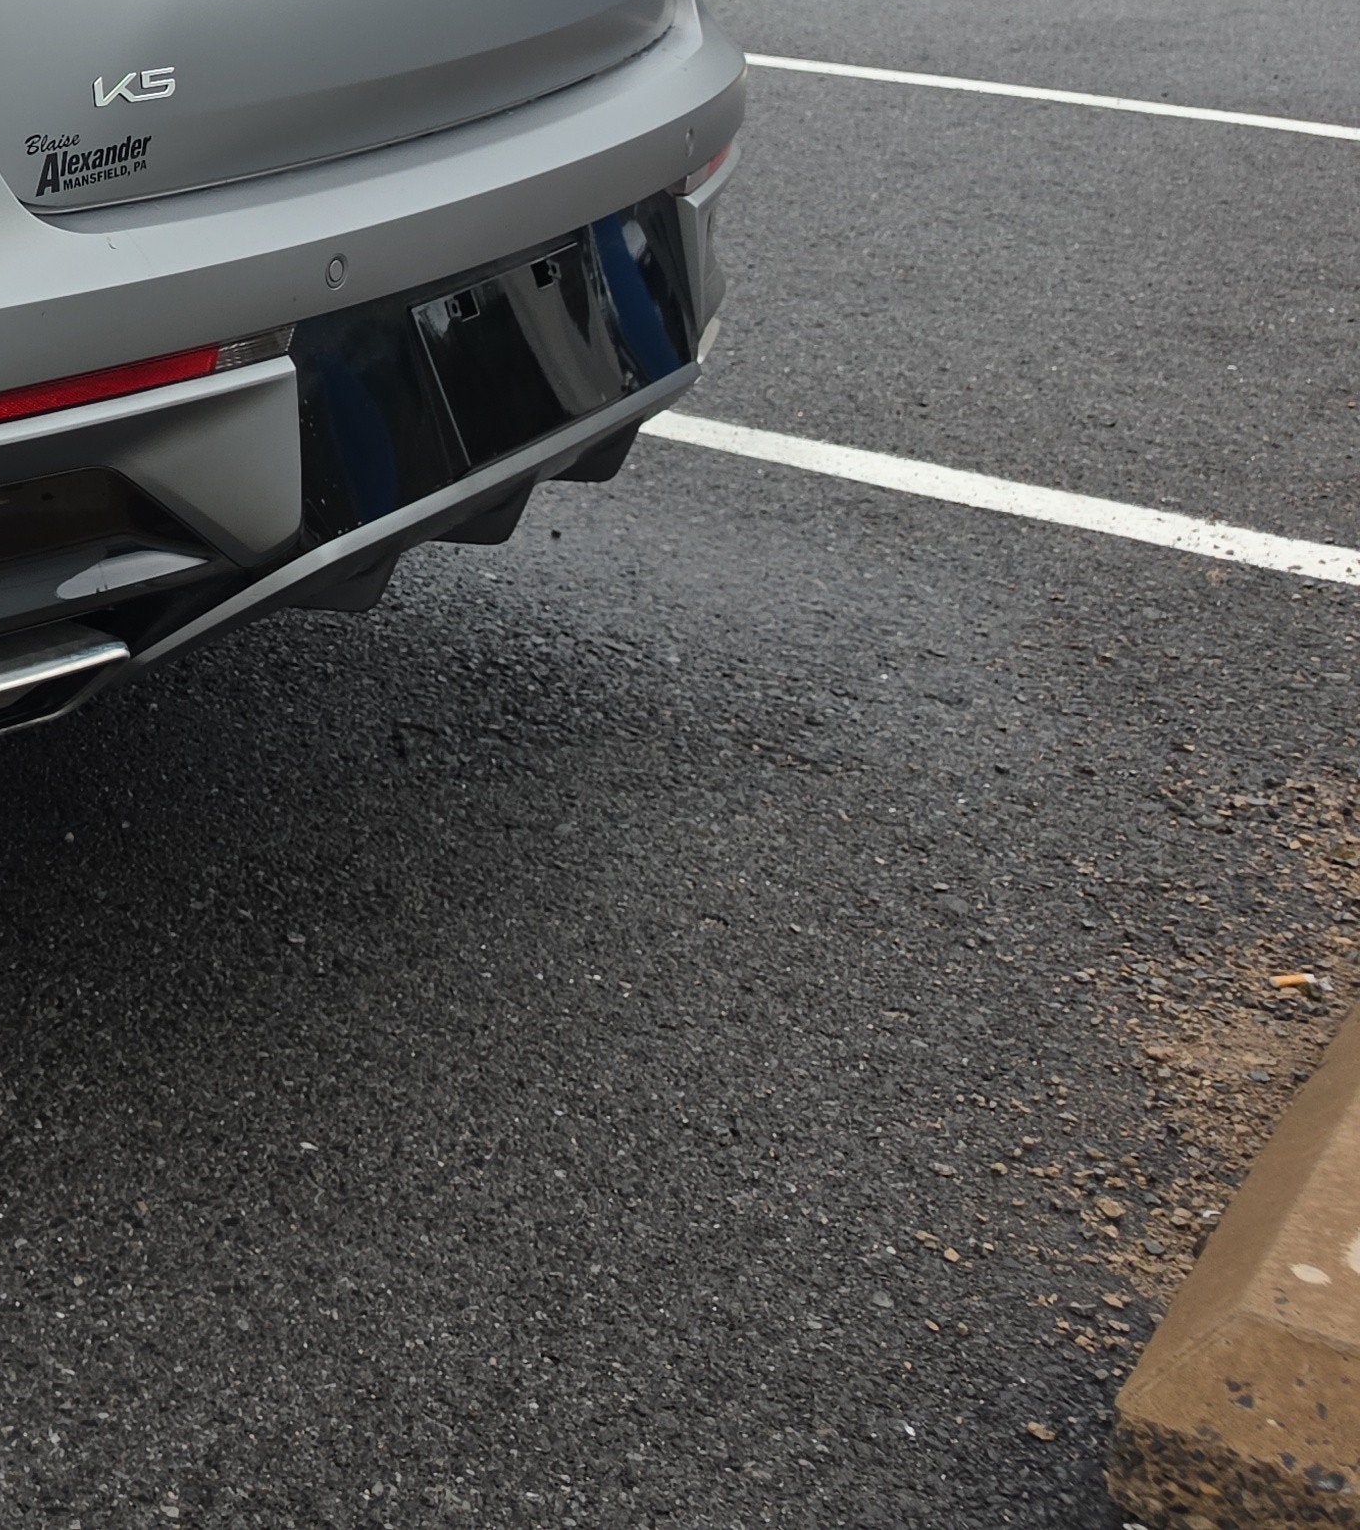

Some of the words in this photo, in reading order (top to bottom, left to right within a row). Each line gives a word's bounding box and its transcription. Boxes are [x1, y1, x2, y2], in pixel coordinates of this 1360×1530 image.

[92, 66, 175, 107] K5
[24, 133, 81, 156] Blaise
[35, 134, 152, 197] Alexander
[63, 166, 131, 191] MANSFIELD,
[133, 159, 147, 174] PA
